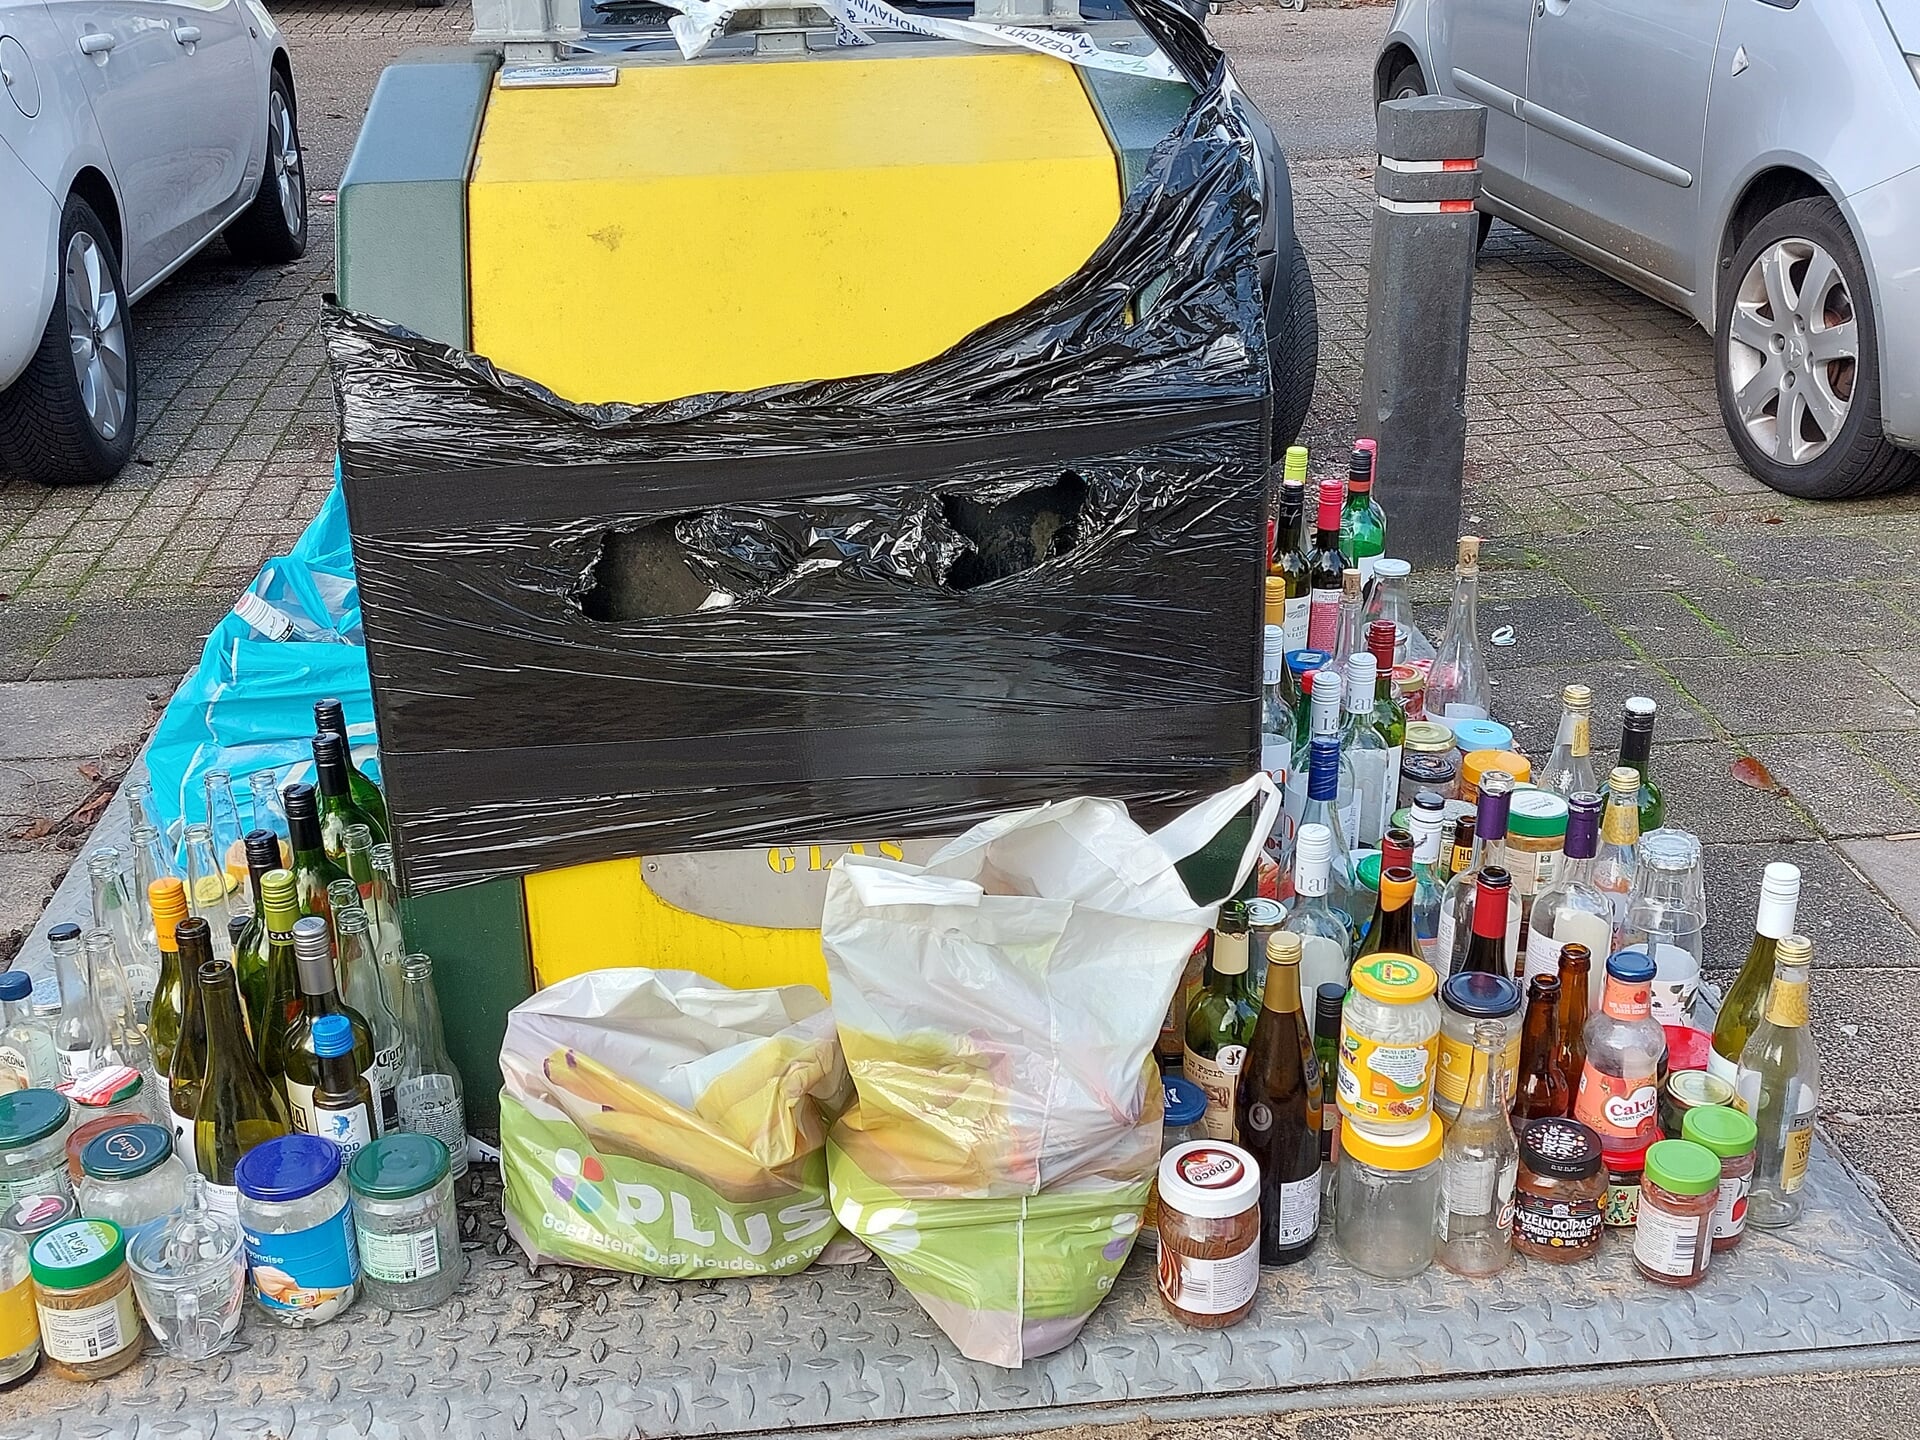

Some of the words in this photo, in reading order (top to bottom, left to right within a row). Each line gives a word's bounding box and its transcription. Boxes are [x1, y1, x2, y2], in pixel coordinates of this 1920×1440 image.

[542, 1212, 589, 1242] Goed
[644, 1245, 688, 1266] Daar
[770, 1253, 799, 1270] we
[801, 1243, 829, 1260] va
[612, 1178, 832, 1256] PLUS
